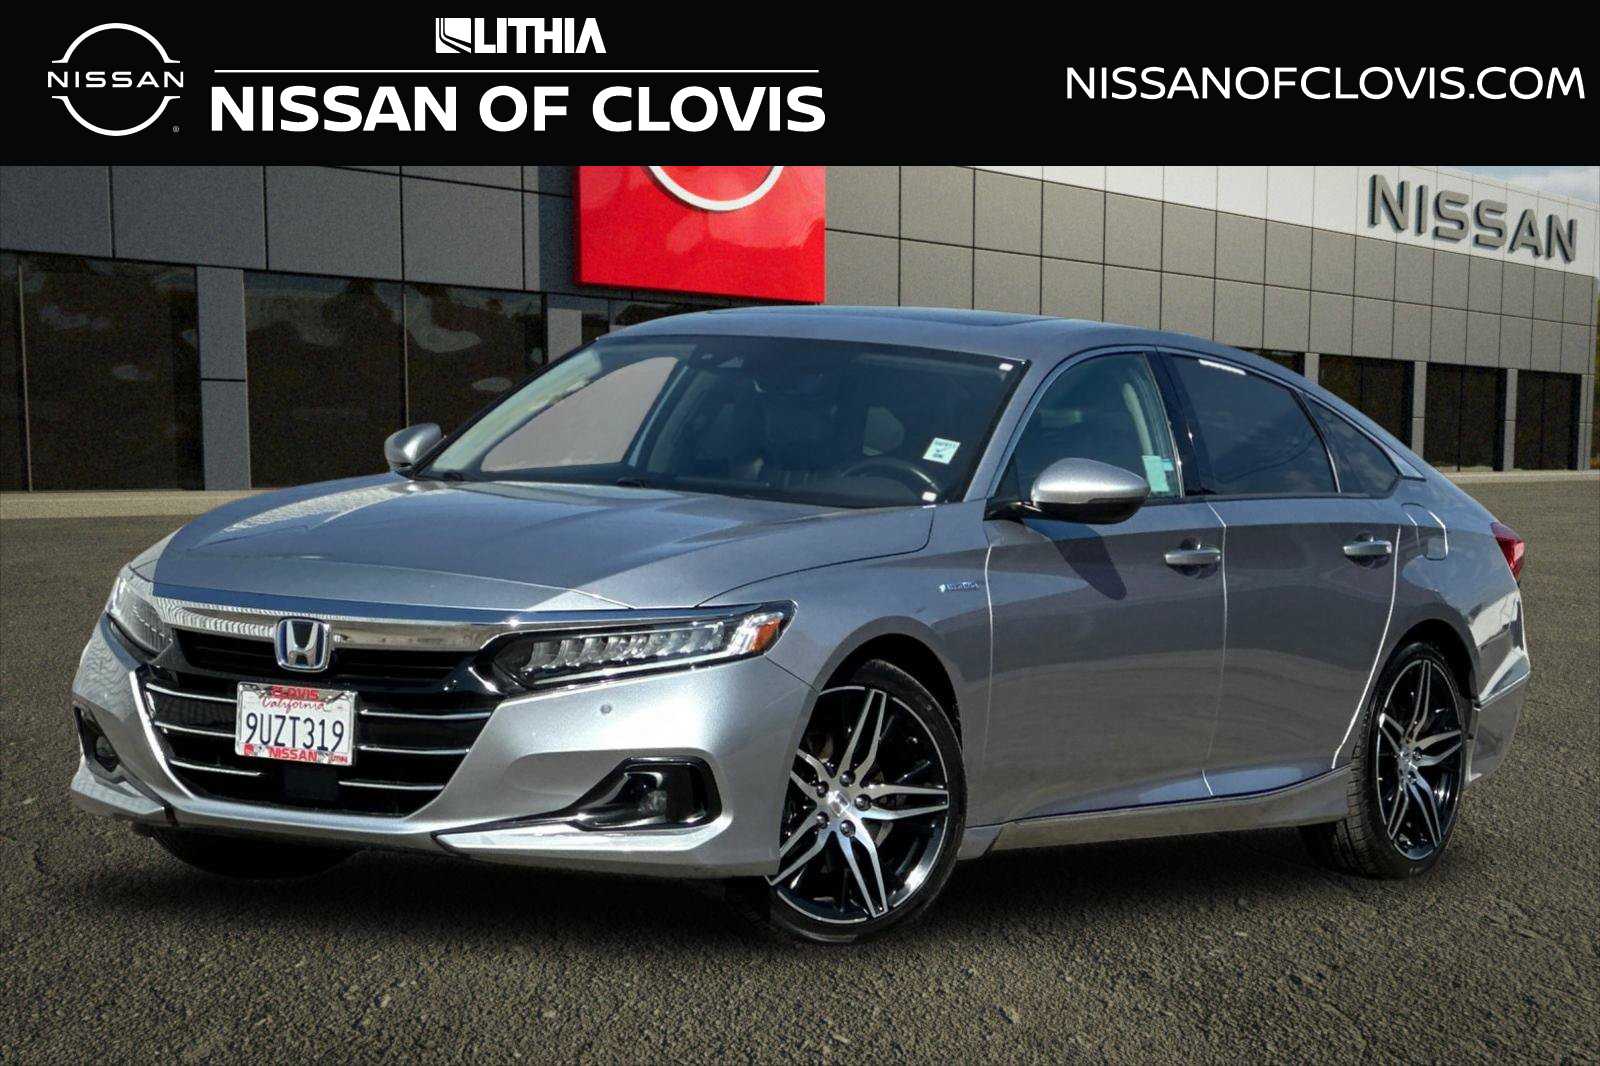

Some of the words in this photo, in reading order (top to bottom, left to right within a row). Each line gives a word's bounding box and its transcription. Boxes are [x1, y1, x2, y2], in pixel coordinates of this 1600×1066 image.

[1368, 174, 1577, 264] NISSAN
[262, 697, 325, 713] California
[245, 712, 344, 752] 9UZT319
[268, 747, 319, 762] NISSAN
